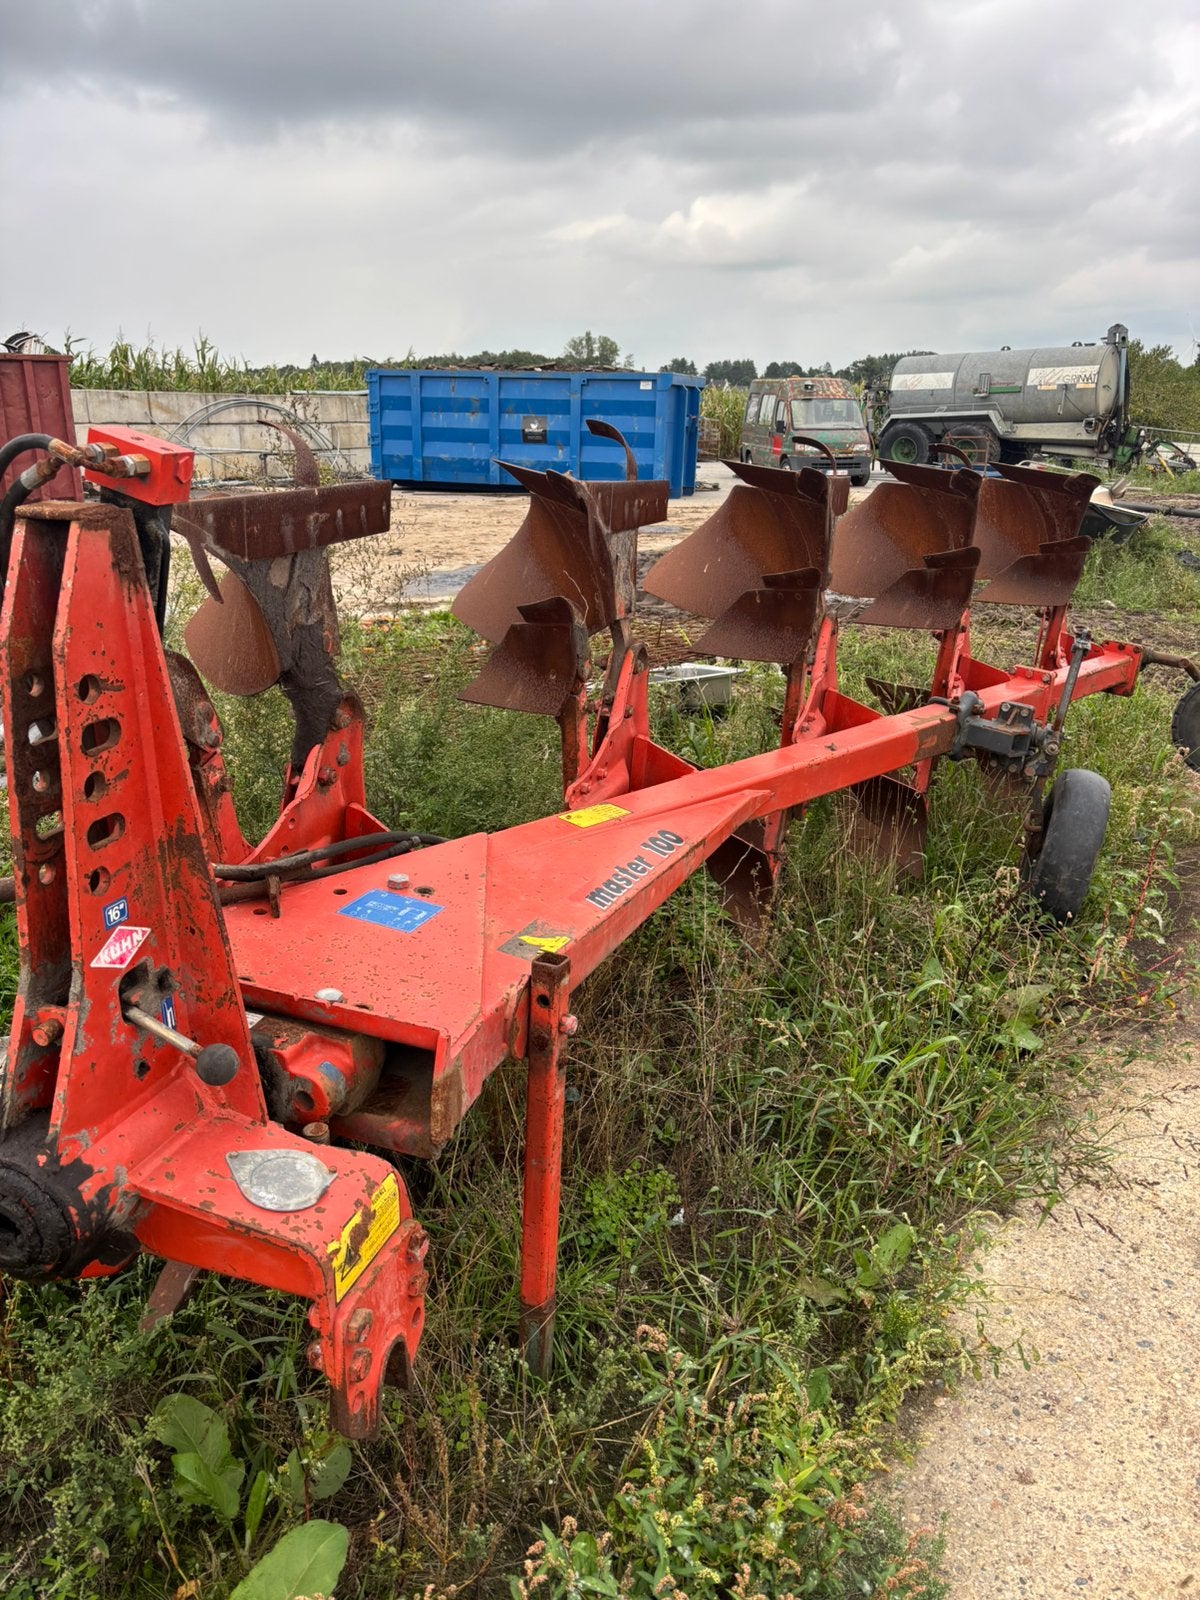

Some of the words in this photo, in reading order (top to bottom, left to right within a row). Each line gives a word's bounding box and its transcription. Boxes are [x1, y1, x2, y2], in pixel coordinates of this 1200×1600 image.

[585, 855, 654, 910] master
[640, 829, 684, 858] 100
[99, 929, 143, 965] KUHN
